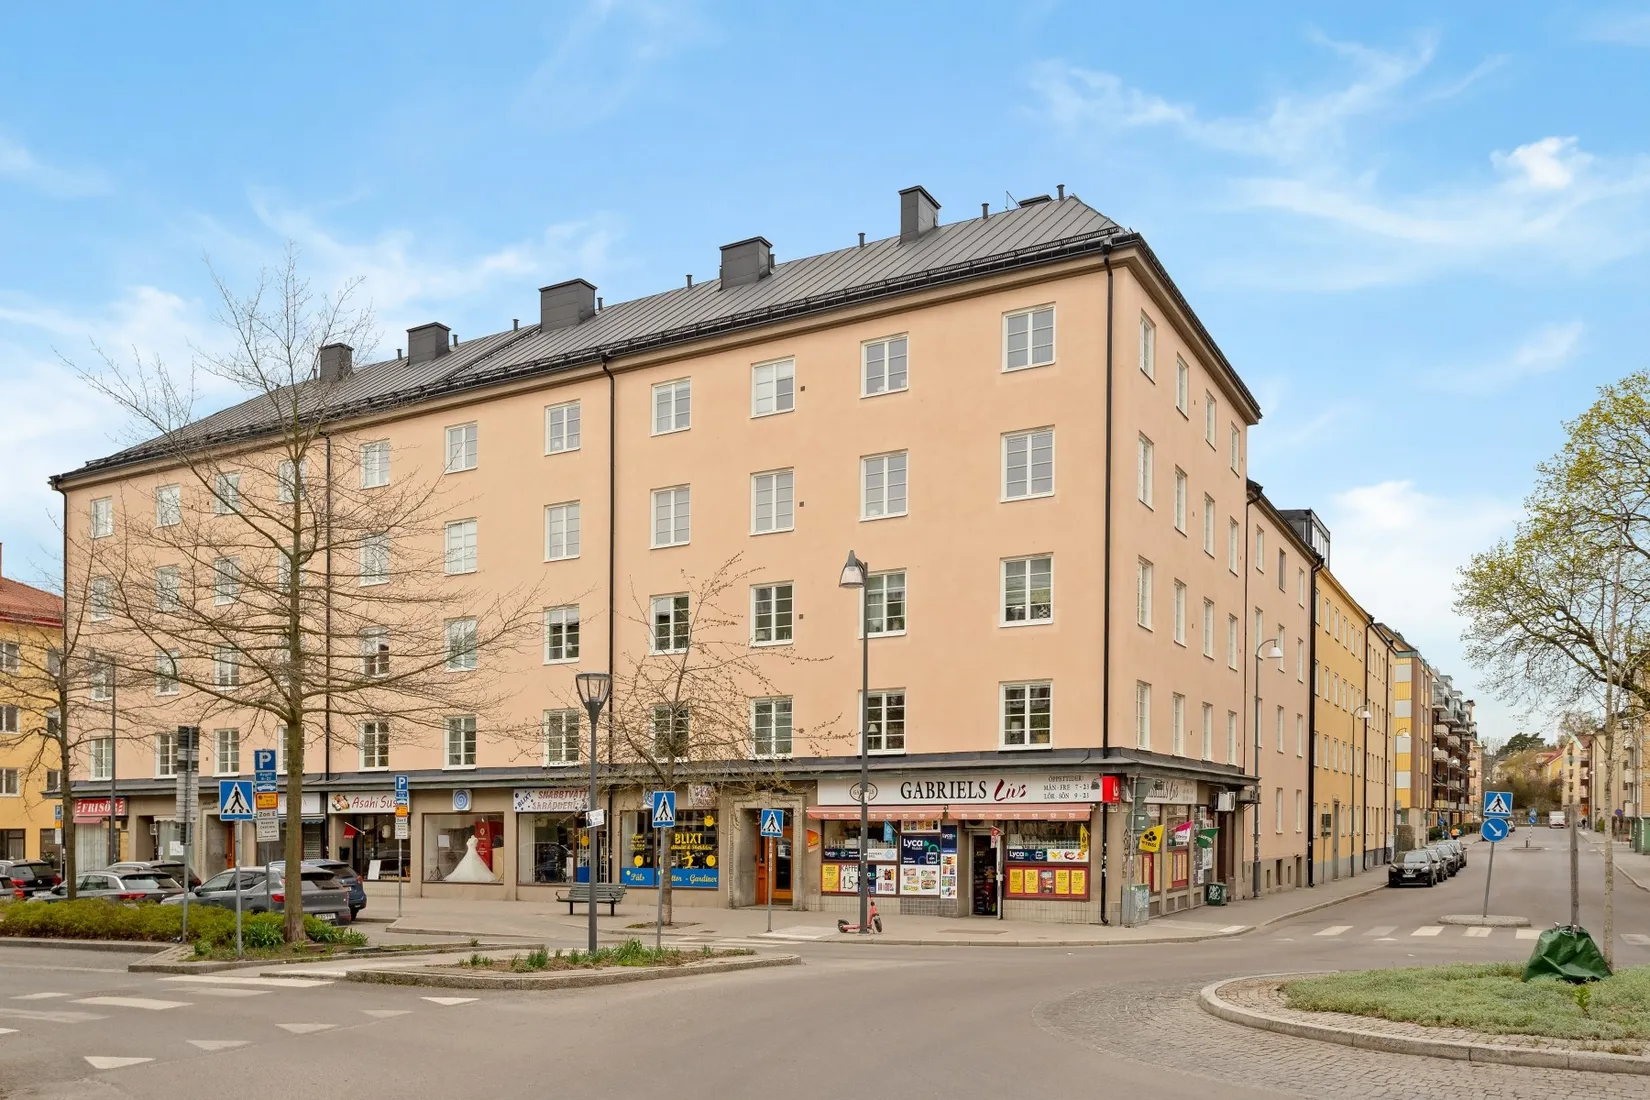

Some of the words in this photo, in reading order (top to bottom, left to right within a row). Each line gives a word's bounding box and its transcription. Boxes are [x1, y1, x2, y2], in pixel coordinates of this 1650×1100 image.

[259, 752, 271, 769] P
[399, 777, 406, 789] P
[900, 780, 987, 800] GABRIELS
[993, 778, 1027, 801] Livs
[516, 791, 533, 808] BLIXT
[538, 789, 588, 799] SNABBTVÄTT
[352, 796, 379, 809] Asahi
[380, 795, 397, 809] Sus
[674, 833, 703, 844] BLIXT
[903, 838, 923, 848] Lyca
